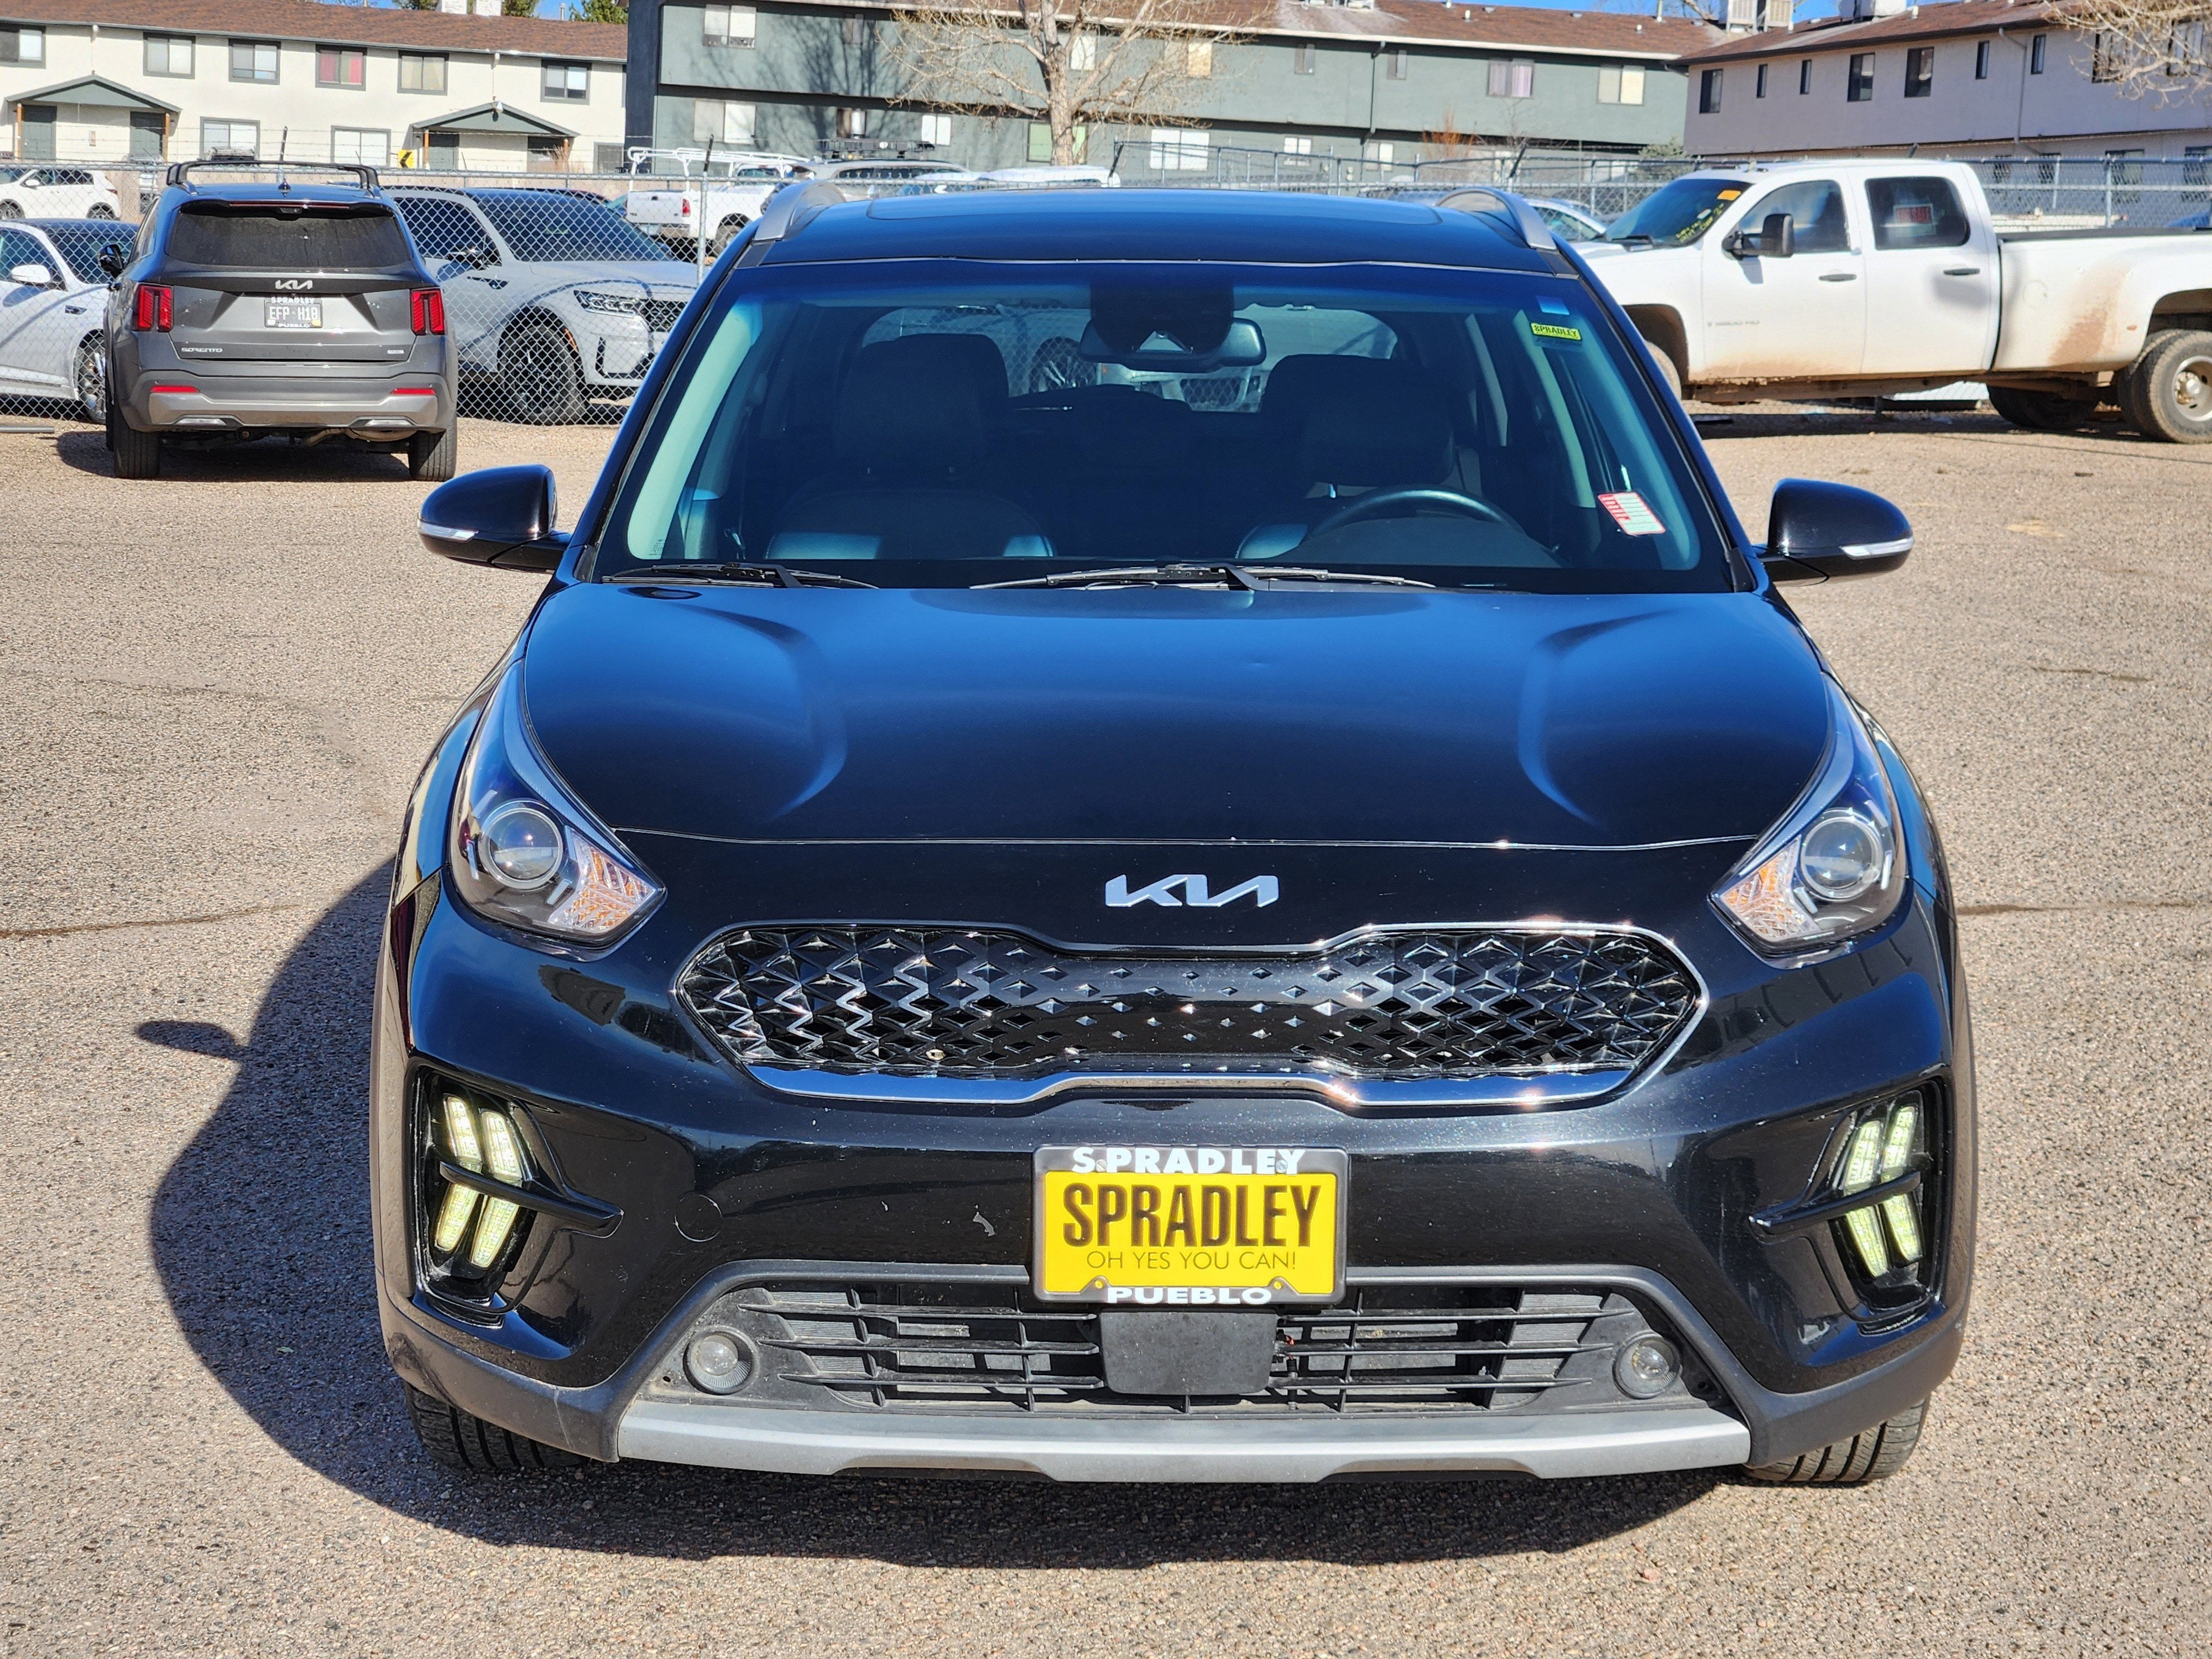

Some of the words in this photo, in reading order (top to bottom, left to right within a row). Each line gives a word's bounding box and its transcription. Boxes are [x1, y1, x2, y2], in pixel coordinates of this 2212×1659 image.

[275, 280, 313, 290] KIA
[269, 306, 290, 320] EFP
[1105, 874, 1279, 907] KIA
[1072, 1146, 1306, 1175] SPRADLEY
[1062, 1182, 1322, 1247] SPRADLEY
[1087, 1251, 1123, 1269] OH
[1133, 1251, 1171, 1269] YES
[1180, 1251, 1230, 1269] YOU
[1239, 1251, 1296, 1269] CAN!
[1108, 1287, 1272, 1305] PUEBLO
